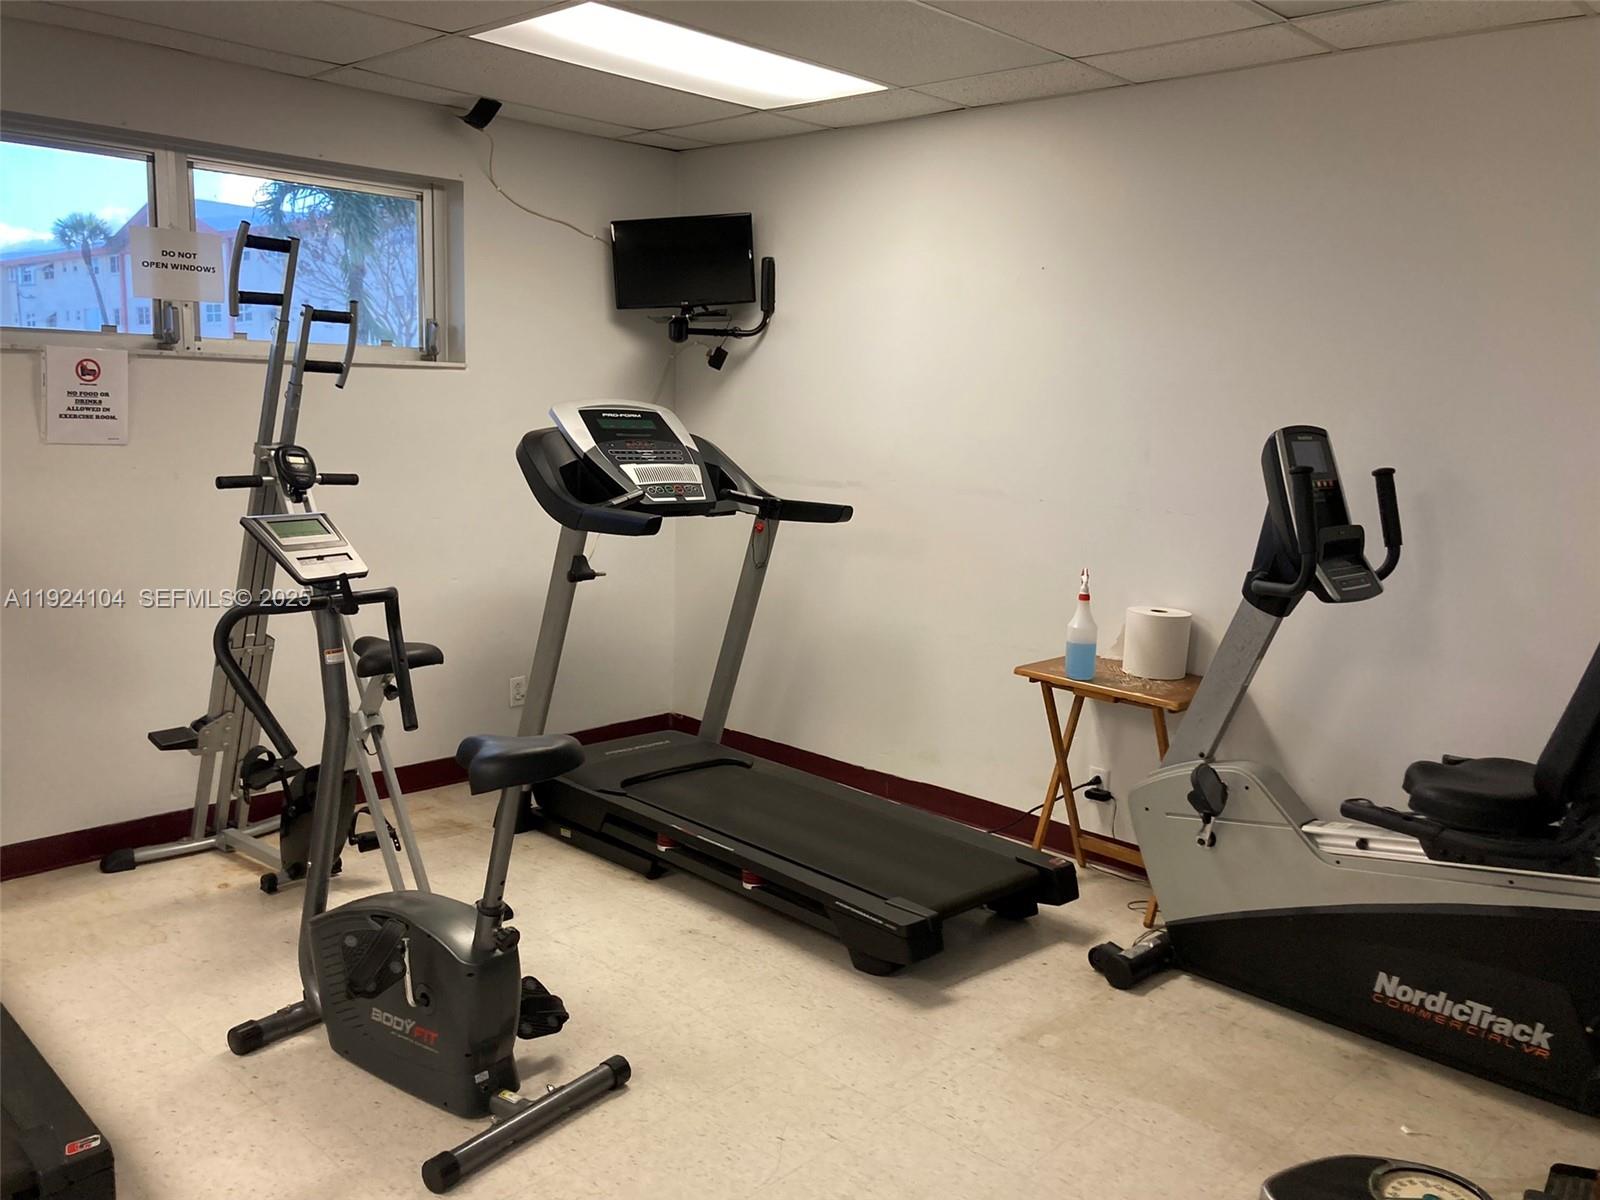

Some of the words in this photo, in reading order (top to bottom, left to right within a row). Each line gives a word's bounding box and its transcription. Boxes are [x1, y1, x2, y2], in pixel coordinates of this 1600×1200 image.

[161, 249, 176, 258] DO
[177, 251, 197, 260] NOT
[141, 260, 169, 269] OPEN
[170, 263, 216, 274] WINDOWS
[66, 390, 78, 398] NO
[79, 390, 99, 398] FOOD
[74, 398, 103, 406] DRINKS
[1373, 971, 1554, 1050] NordicTrack
[1371, 993, 1516, 1049] COMMERCIAL
